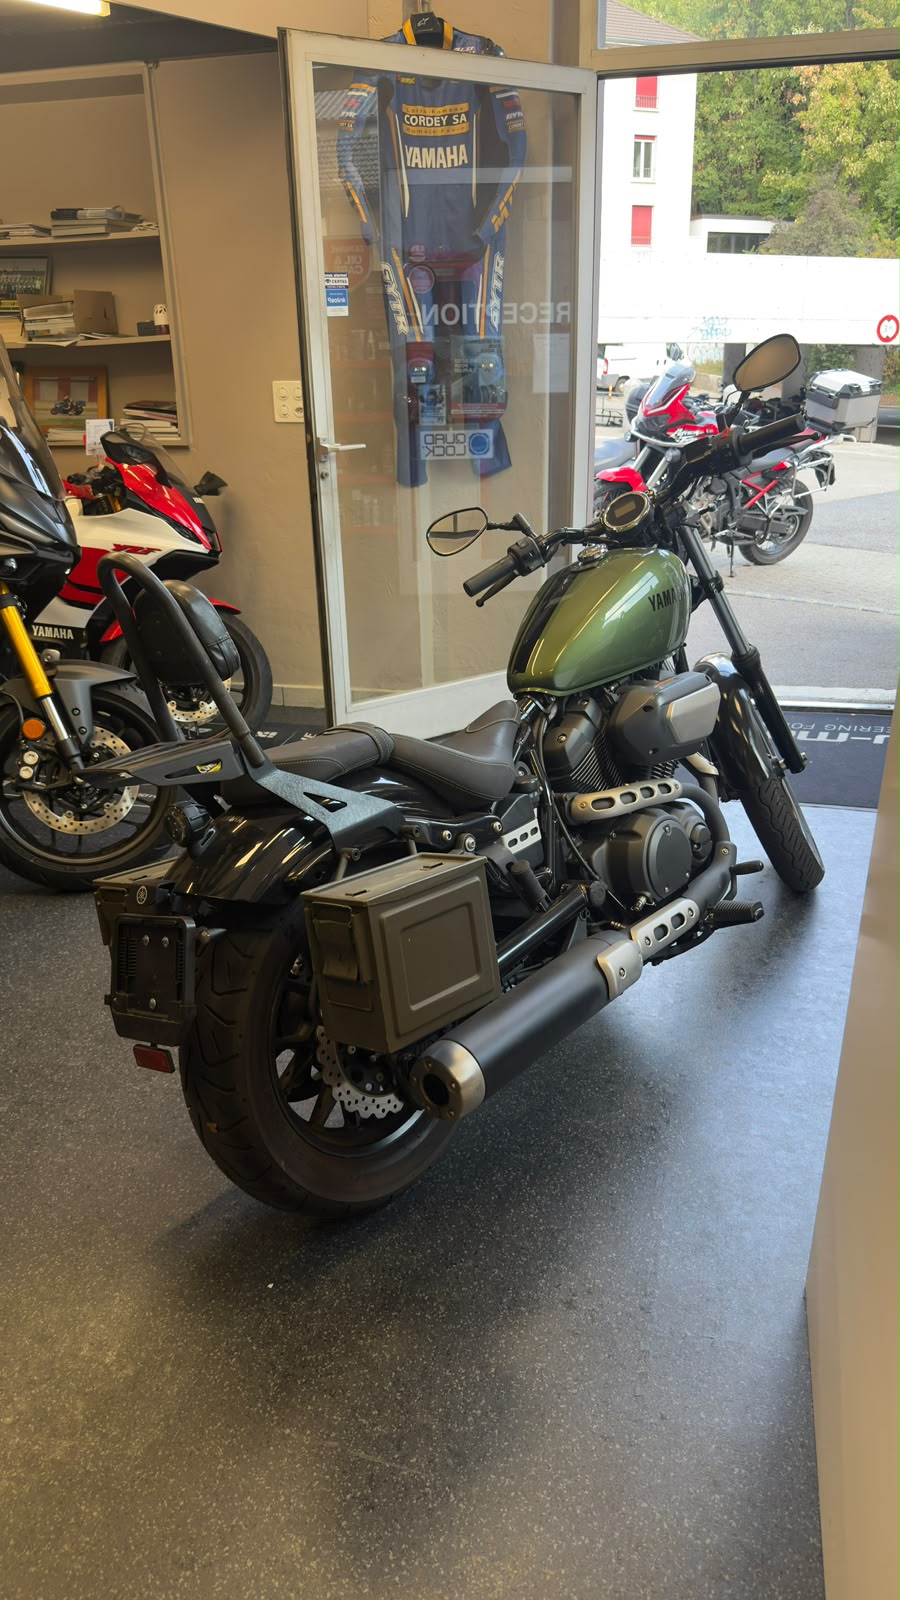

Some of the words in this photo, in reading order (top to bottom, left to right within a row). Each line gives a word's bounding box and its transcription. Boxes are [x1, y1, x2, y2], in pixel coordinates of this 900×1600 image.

[404, 114, 449, 127] CORDEY
[452, 113, 467, 125] SA
[404, 144, 469, 168] YAMAHA
[381, 262, 409, 336] GYTR
[31, 624, 75, 640] YAMAHA
[787, 722, 815, 730] FO
